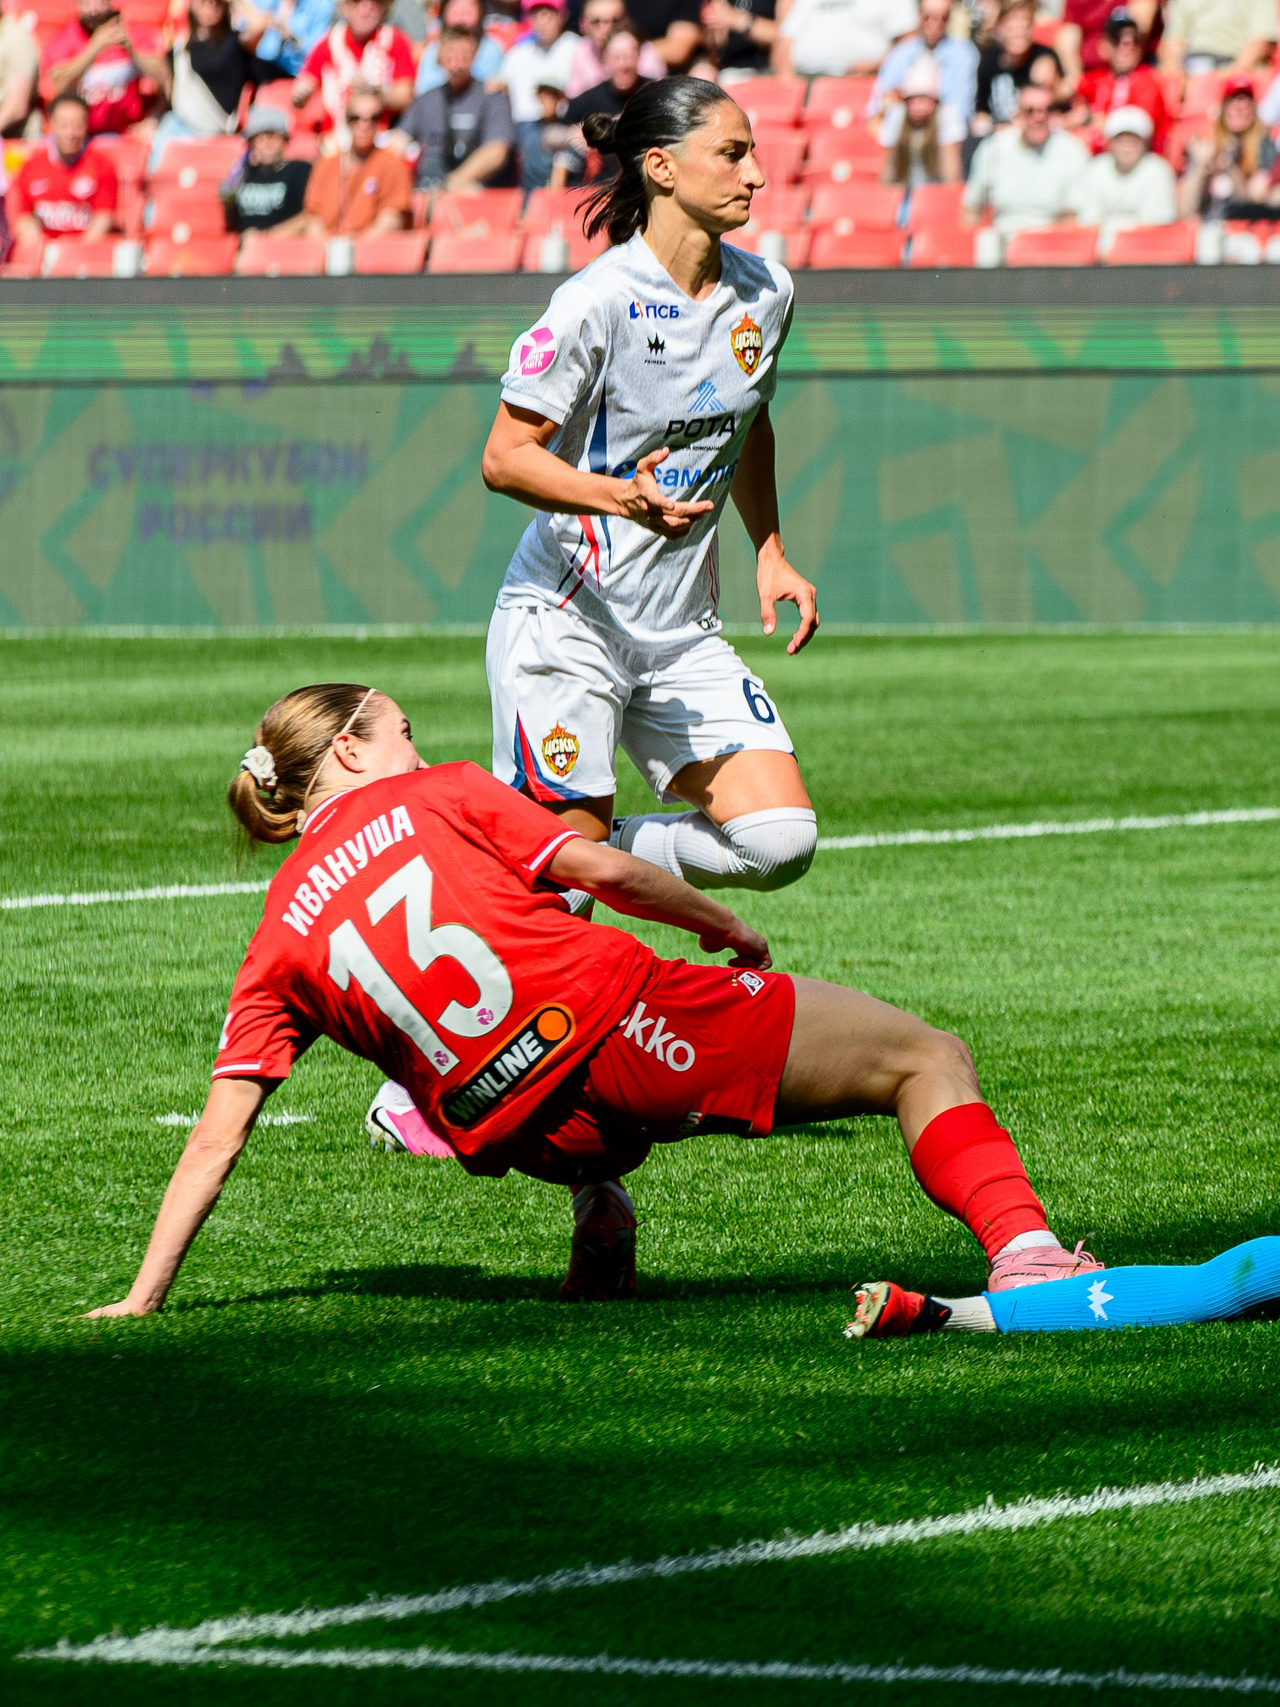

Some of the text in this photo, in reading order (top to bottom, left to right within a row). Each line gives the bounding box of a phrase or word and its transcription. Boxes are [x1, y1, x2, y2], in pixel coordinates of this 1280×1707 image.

[645, 304, 680, 319] ПСБ
[735, 331, 762, 350] ЦСКА
[663, 415, 736, 439] РОТА
[743, 677, 775, 724] 6
[544, 736, 577, 756] ЦСКА
[282, 805, 415, 937] ИВАНУША
[327, 854, 513, 1077] 13
[450, 1030, 544, 1121] WINLINE
